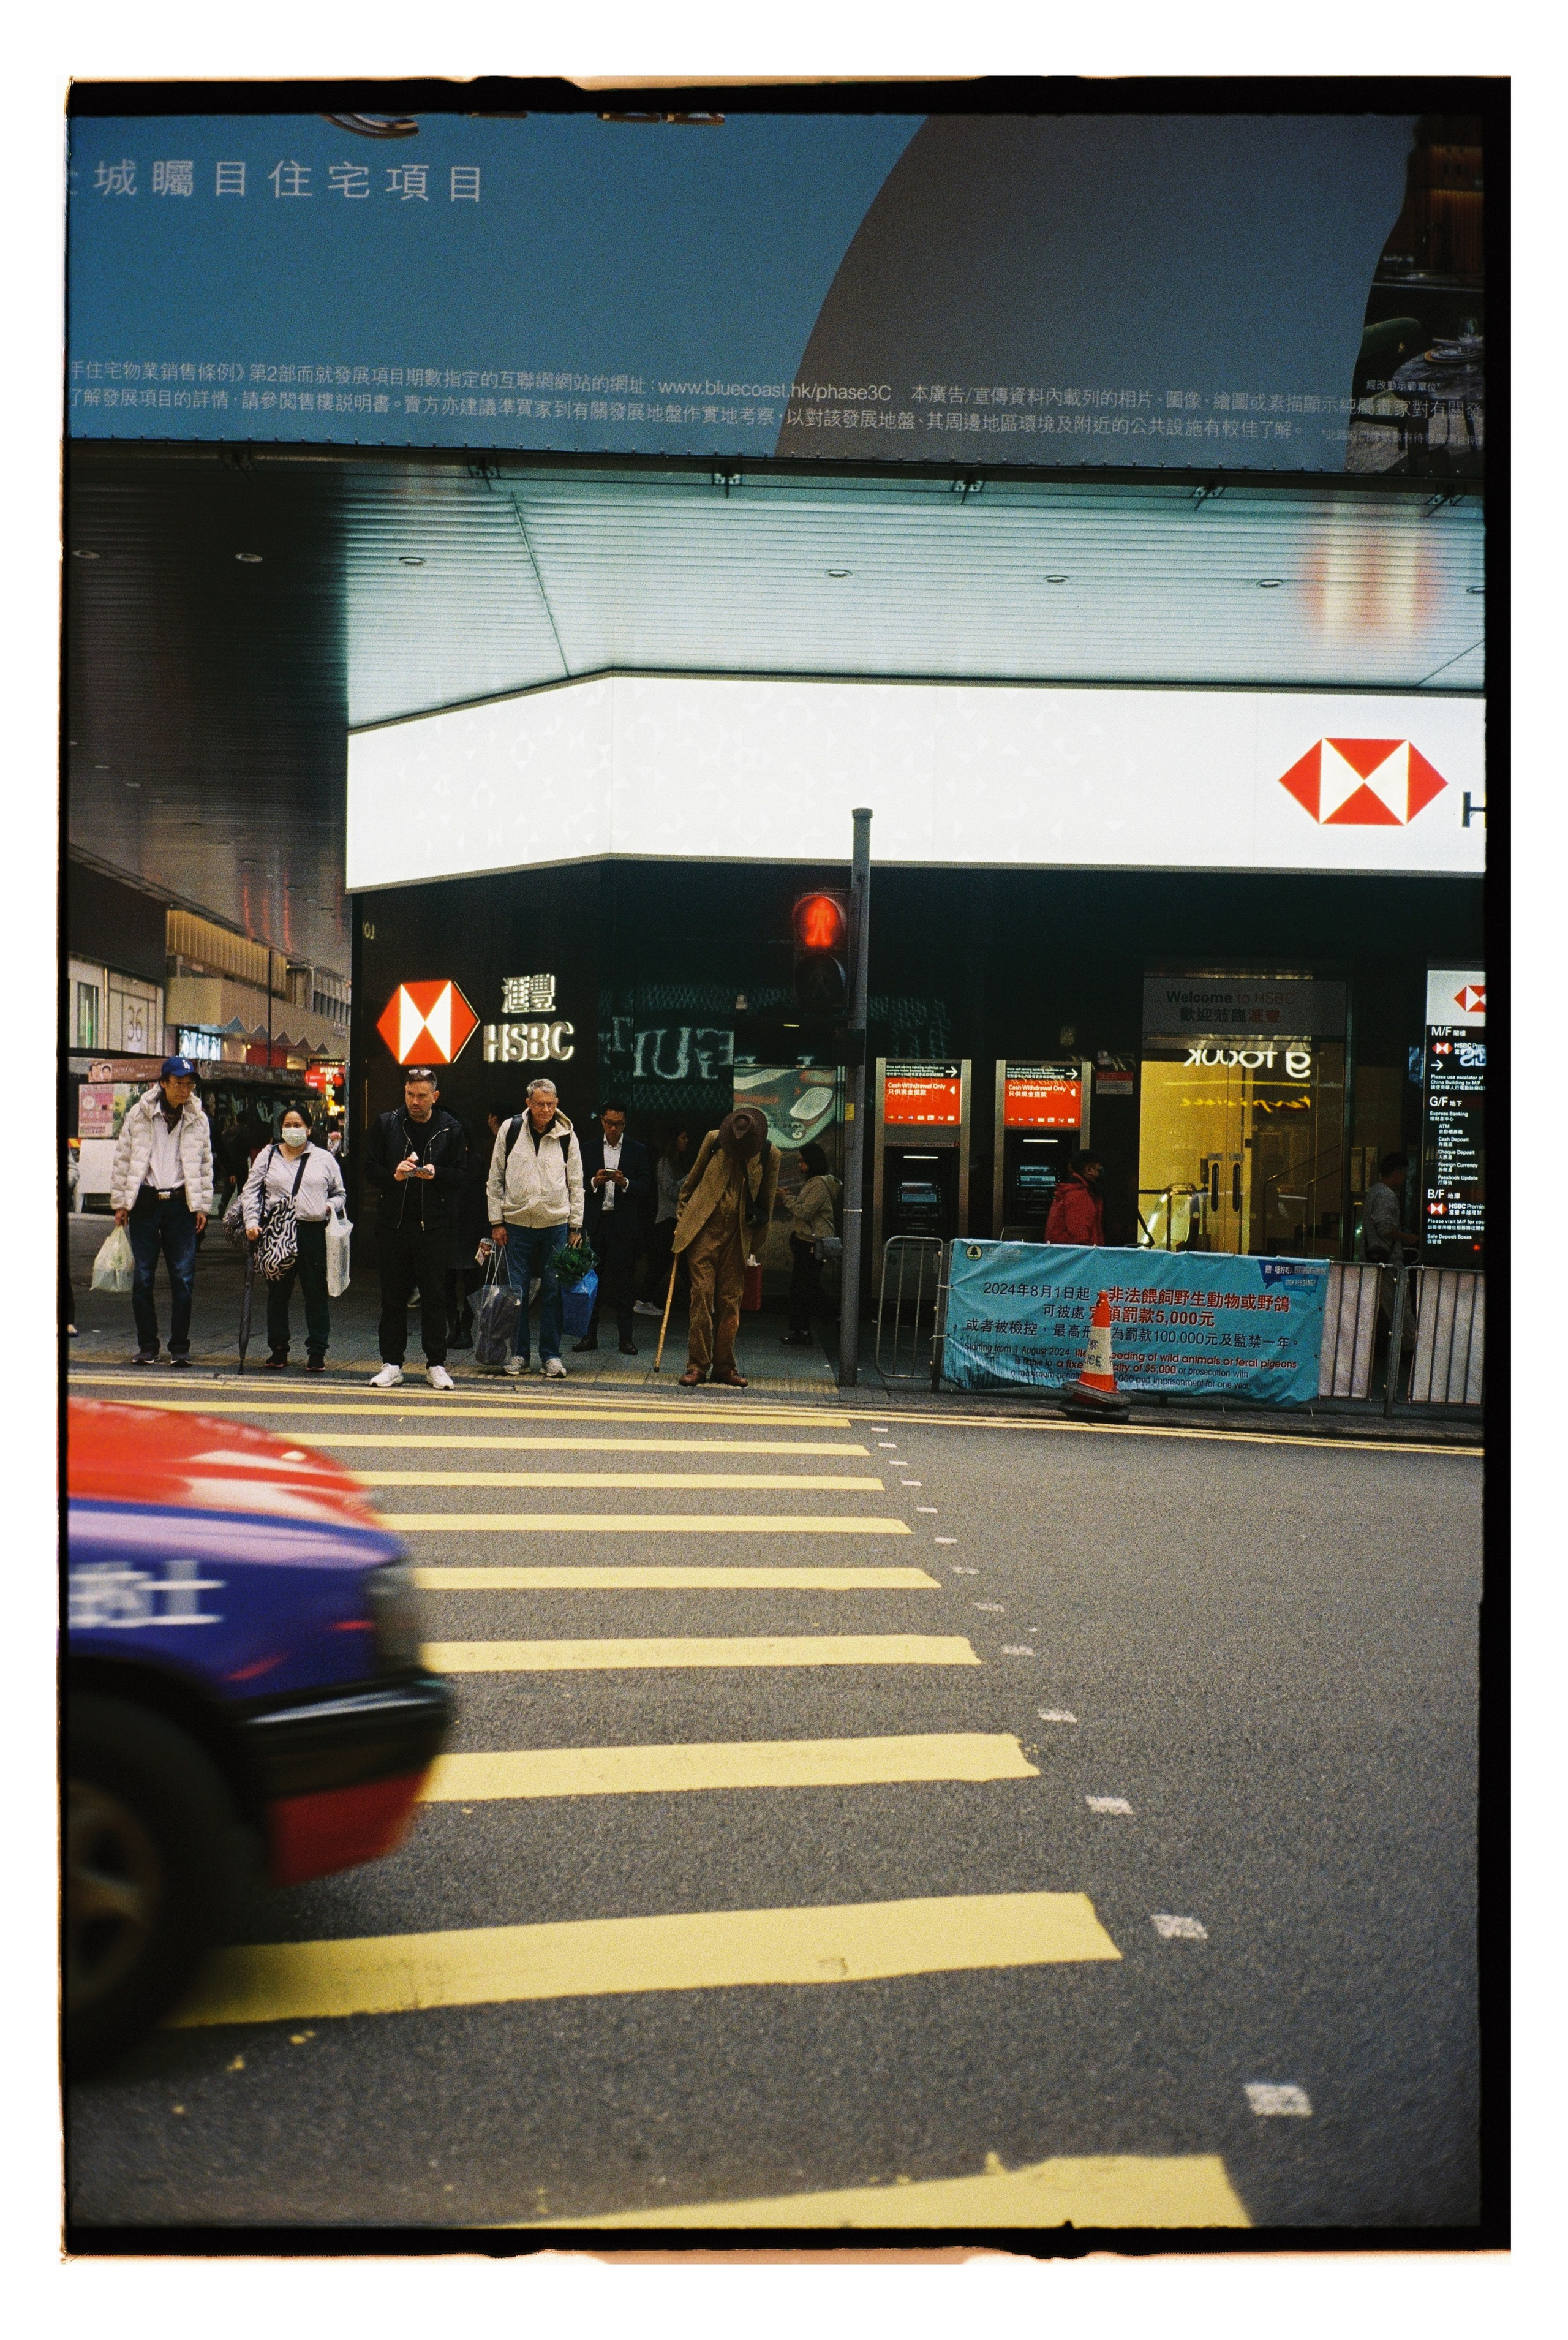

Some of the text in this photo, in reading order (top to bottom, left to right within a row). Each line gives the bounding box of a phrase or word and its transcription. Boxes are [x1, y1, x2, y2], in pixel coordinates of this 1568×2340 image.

[69, 159, 481, 203] 城矚目住宅項目
[658, 380, 892, 402] www.bluecoast.hk/phase3C
[1167, 991, 1295, 1005] Welcome to HSBC
[127, 1005, 143, 1041] 36
[1431, 1026, 1452, 1036] M/F
[483, 1021, 574, 1062] HSBC
[1430, 1096, 1448, 1107] G/F
[1428, 1188, 1444, 1199] B/F
[965, 1343, 992, 1353] Starting
[995, 1343, 1011, 1353] from
[1022, 1346, 1046, 1357] August
[1111, 1352, 1145, 1362] eeding
[1148, 1353, 1158, 1361] of
[1159, 1353, 1179, 1363] wild
[1182, 1355, 1221, 1365] animals
[1236, 1357, 1257, 1367] feral
[1261, 1359, 1297, 1370] pigeons
[1046, 1357, 1053, 1367] to
[1066, 1358, 1084, 1368] fixe
[1133, 1364, 1143, 1373] of
[1145, 1364, 1176, 1375] $5,000
[1188, 1367, 1231, 1377] prosecution
[1232, 1369, 1249, 1378] with
[1153, 1376, 1204, 1387] imprisonment
[1205, 1379, 1216, 1387] for
